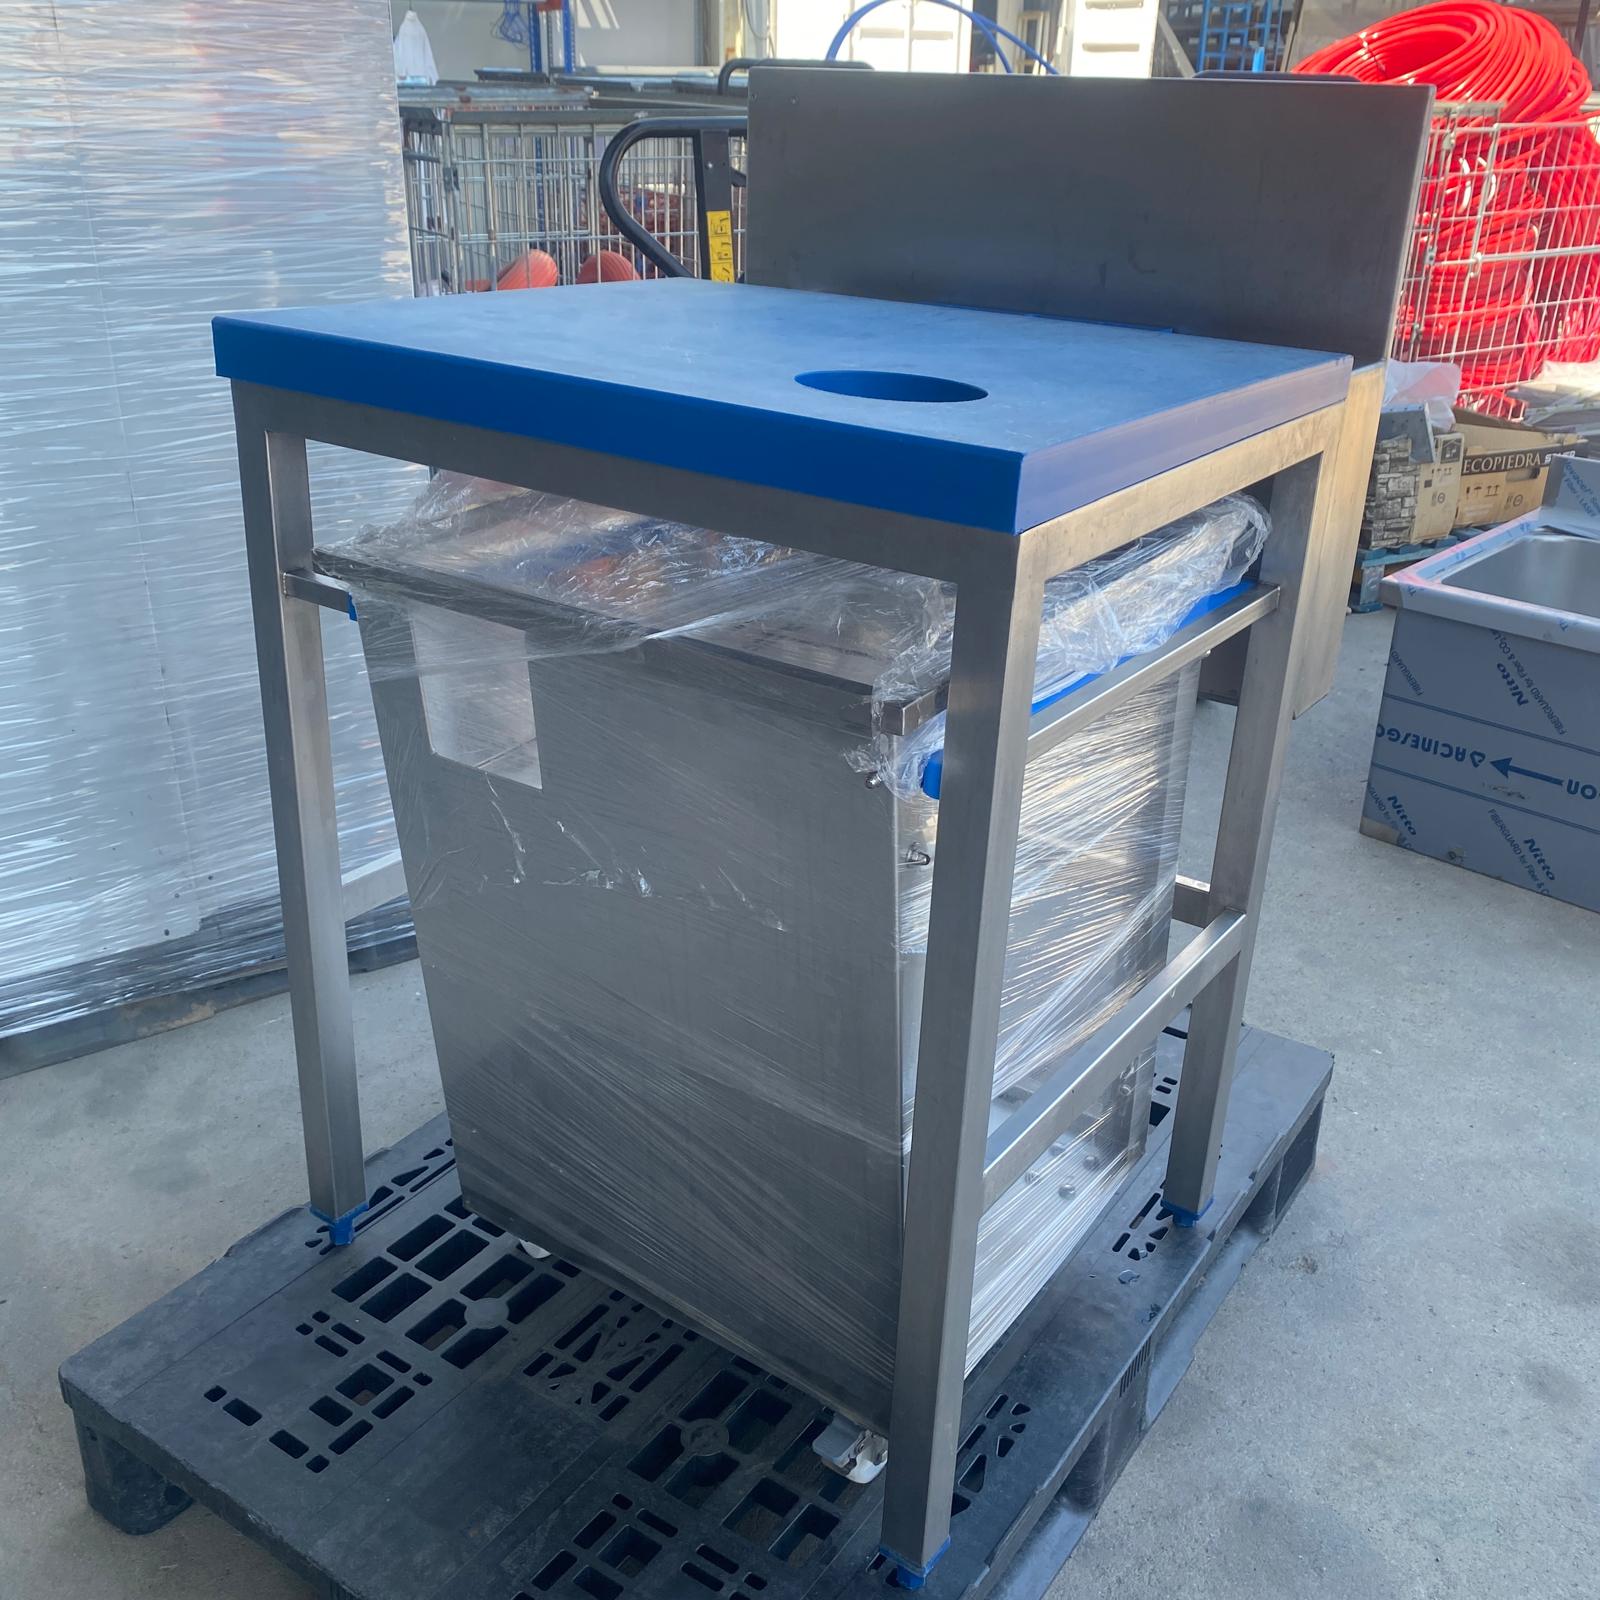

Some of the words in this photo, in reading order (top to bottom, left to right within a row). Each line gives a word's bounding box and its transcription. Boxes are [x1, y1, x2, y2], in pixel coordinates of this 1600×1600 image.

[1463, 452, 1541, 473] ECOPIEDRA
[1497, 662, 1529, 707] Nitto
[1387, 794, 1417, 837] Nitto
[1523, 837, 1556, 881] Nitto
